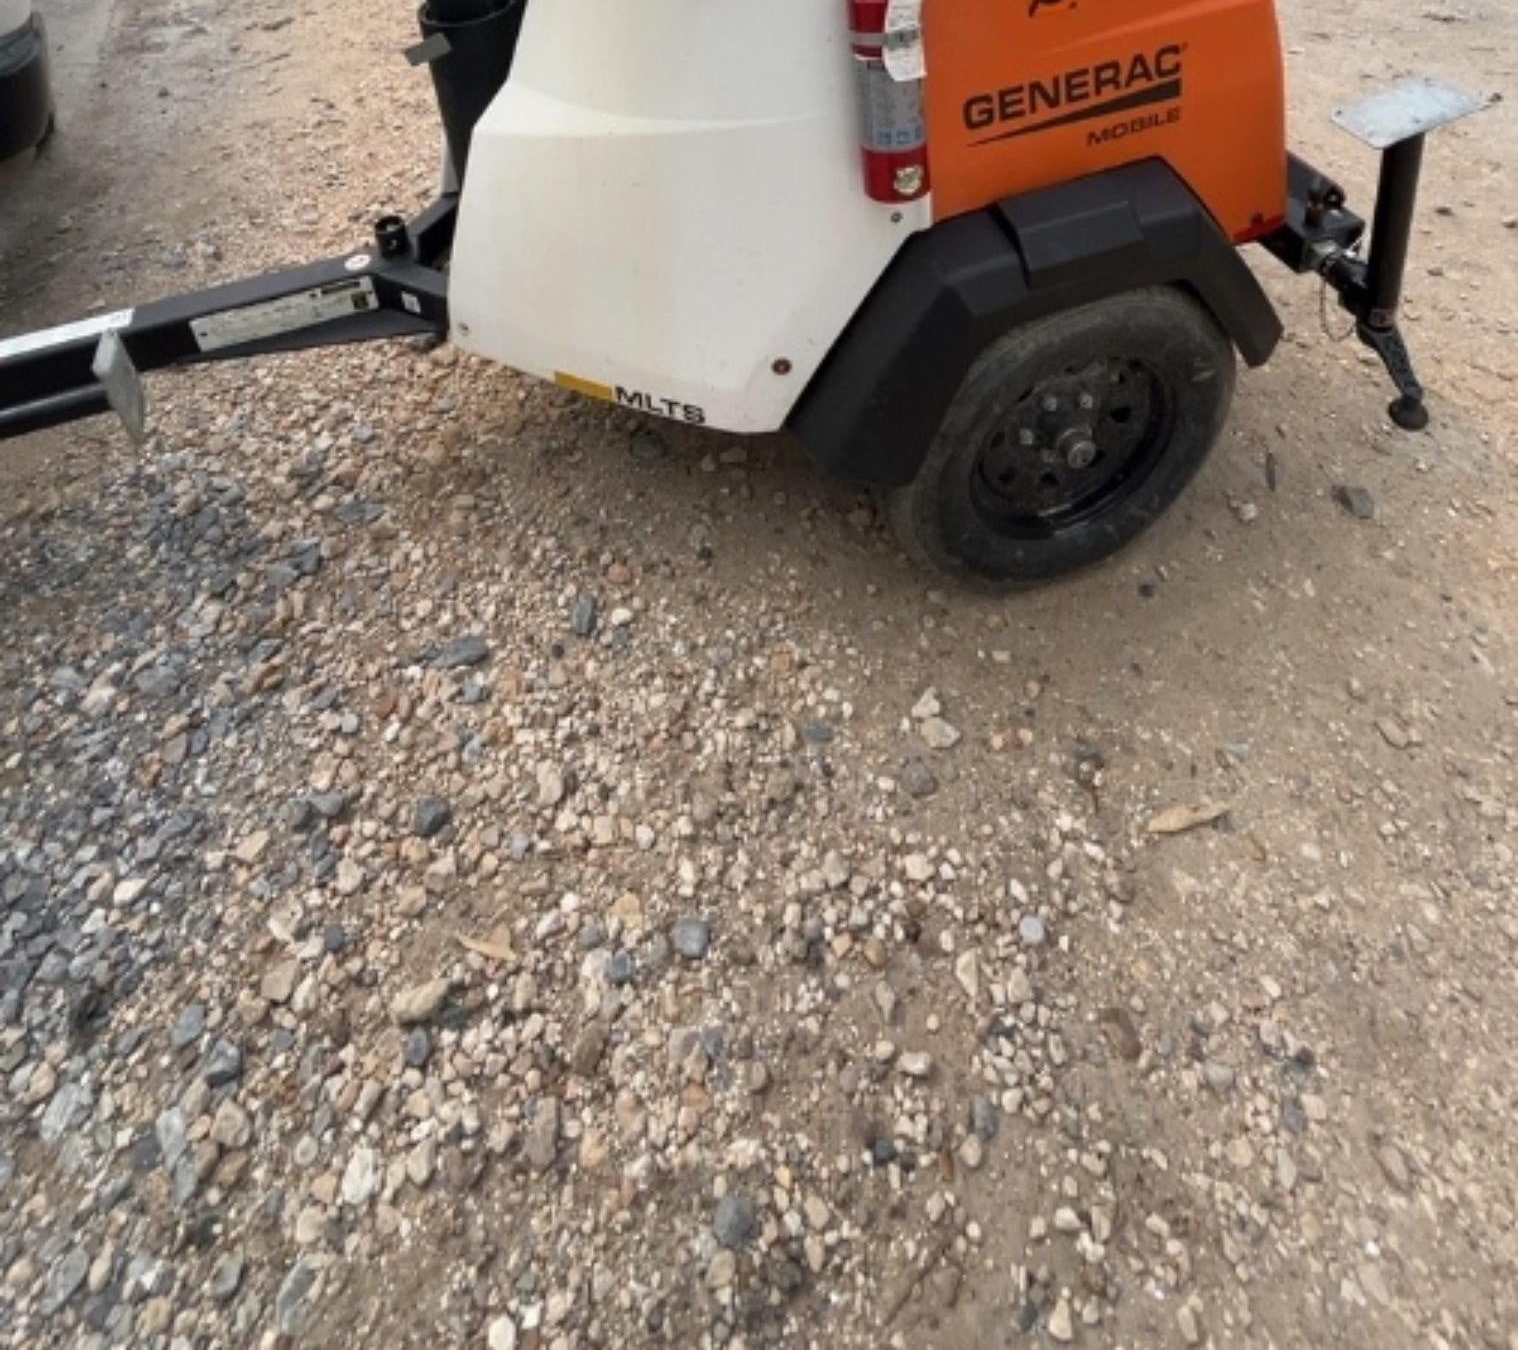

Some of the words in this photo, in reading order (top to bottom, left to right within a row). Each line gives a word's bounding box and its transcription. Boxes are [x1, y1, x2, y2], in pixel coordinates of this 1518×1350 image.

[963, 44, 1182, 130] GENERAC
[1086, 107, 1181, 146] MOBILE
[615, 386, 706, 424] MLTS
